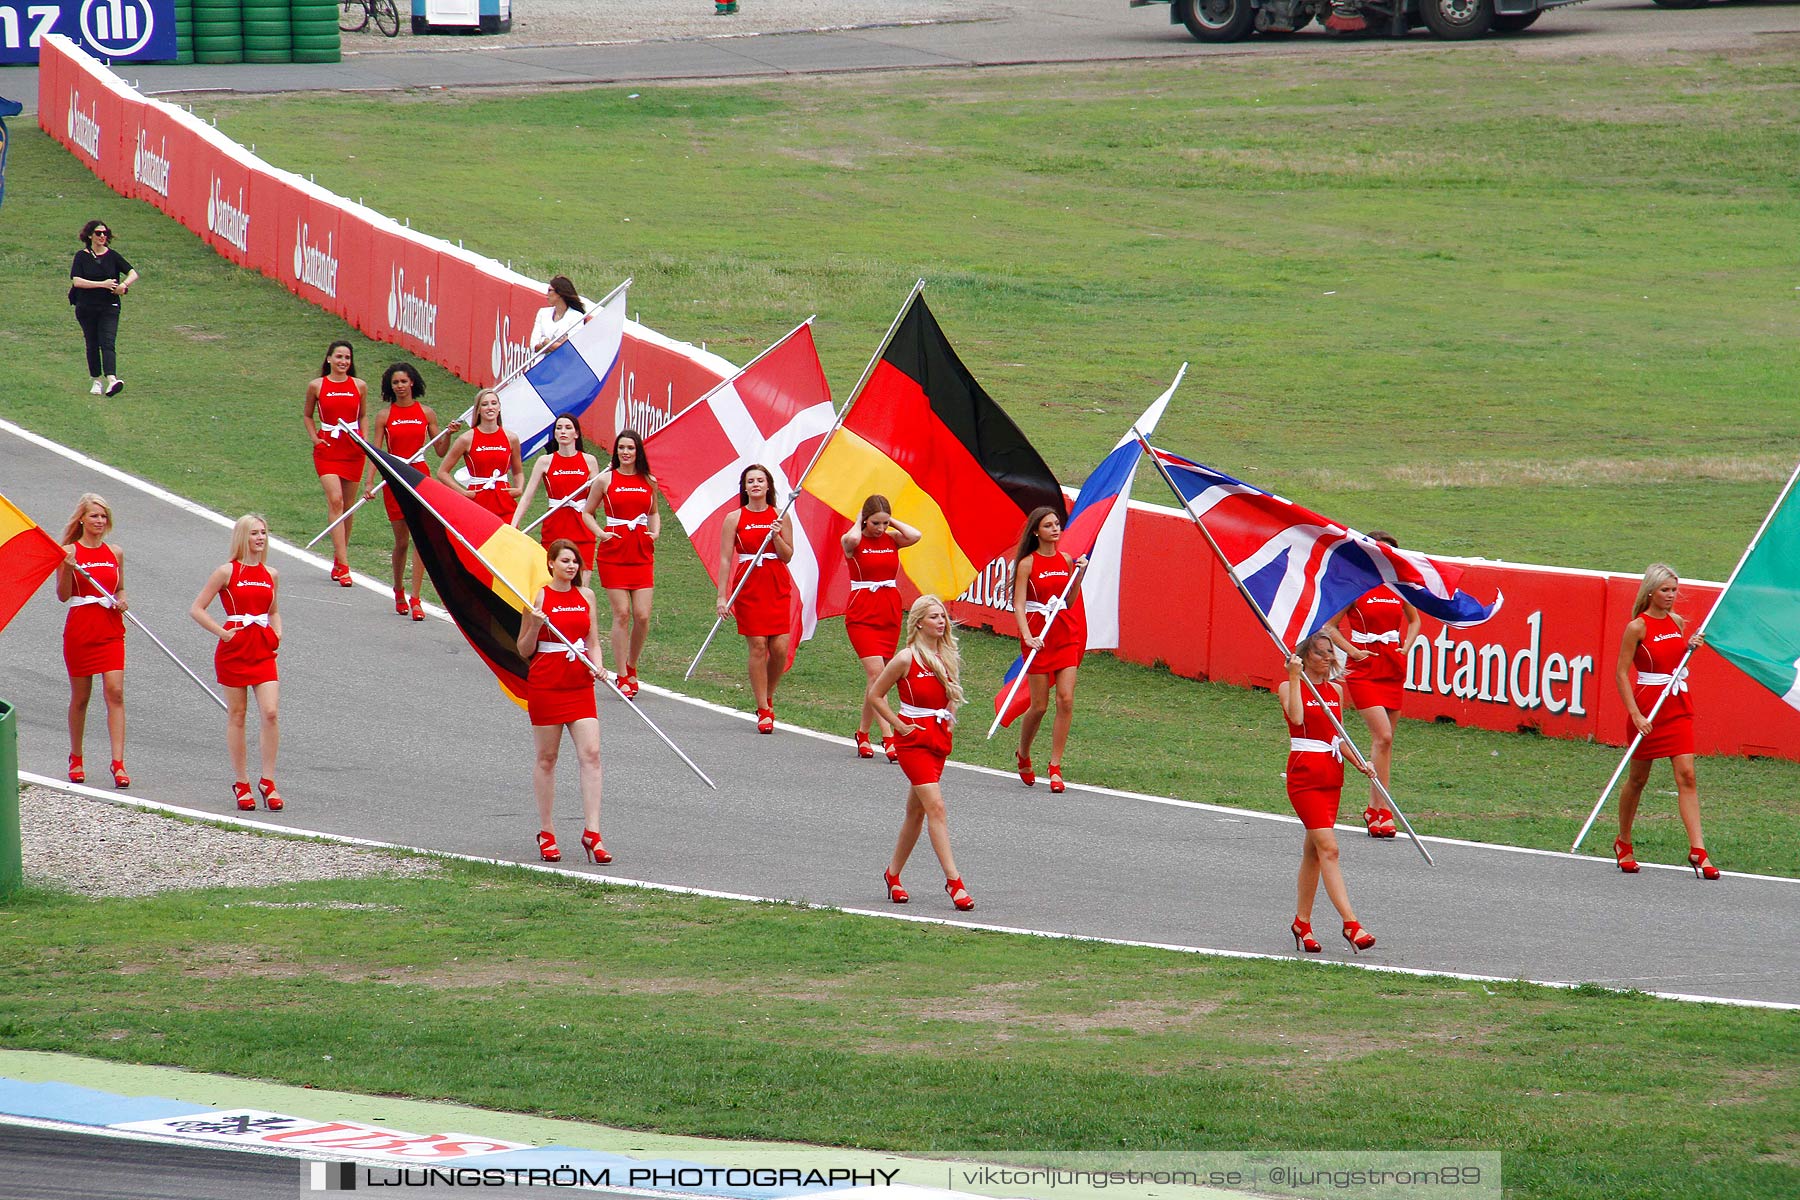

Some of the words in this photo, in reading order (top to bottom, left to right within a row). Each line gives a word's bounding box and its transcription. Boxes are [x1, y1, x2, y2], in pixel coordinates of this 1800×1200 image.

[73, 90, 100, 161] Santander
[141, 129, 170, 197] Santander
[215, 177, 250, 253] Santander
[302, 223, 338, 298] Santander
[397, 267, 437, 347] Santander
[261, 1121, 511, 1157] UBS
